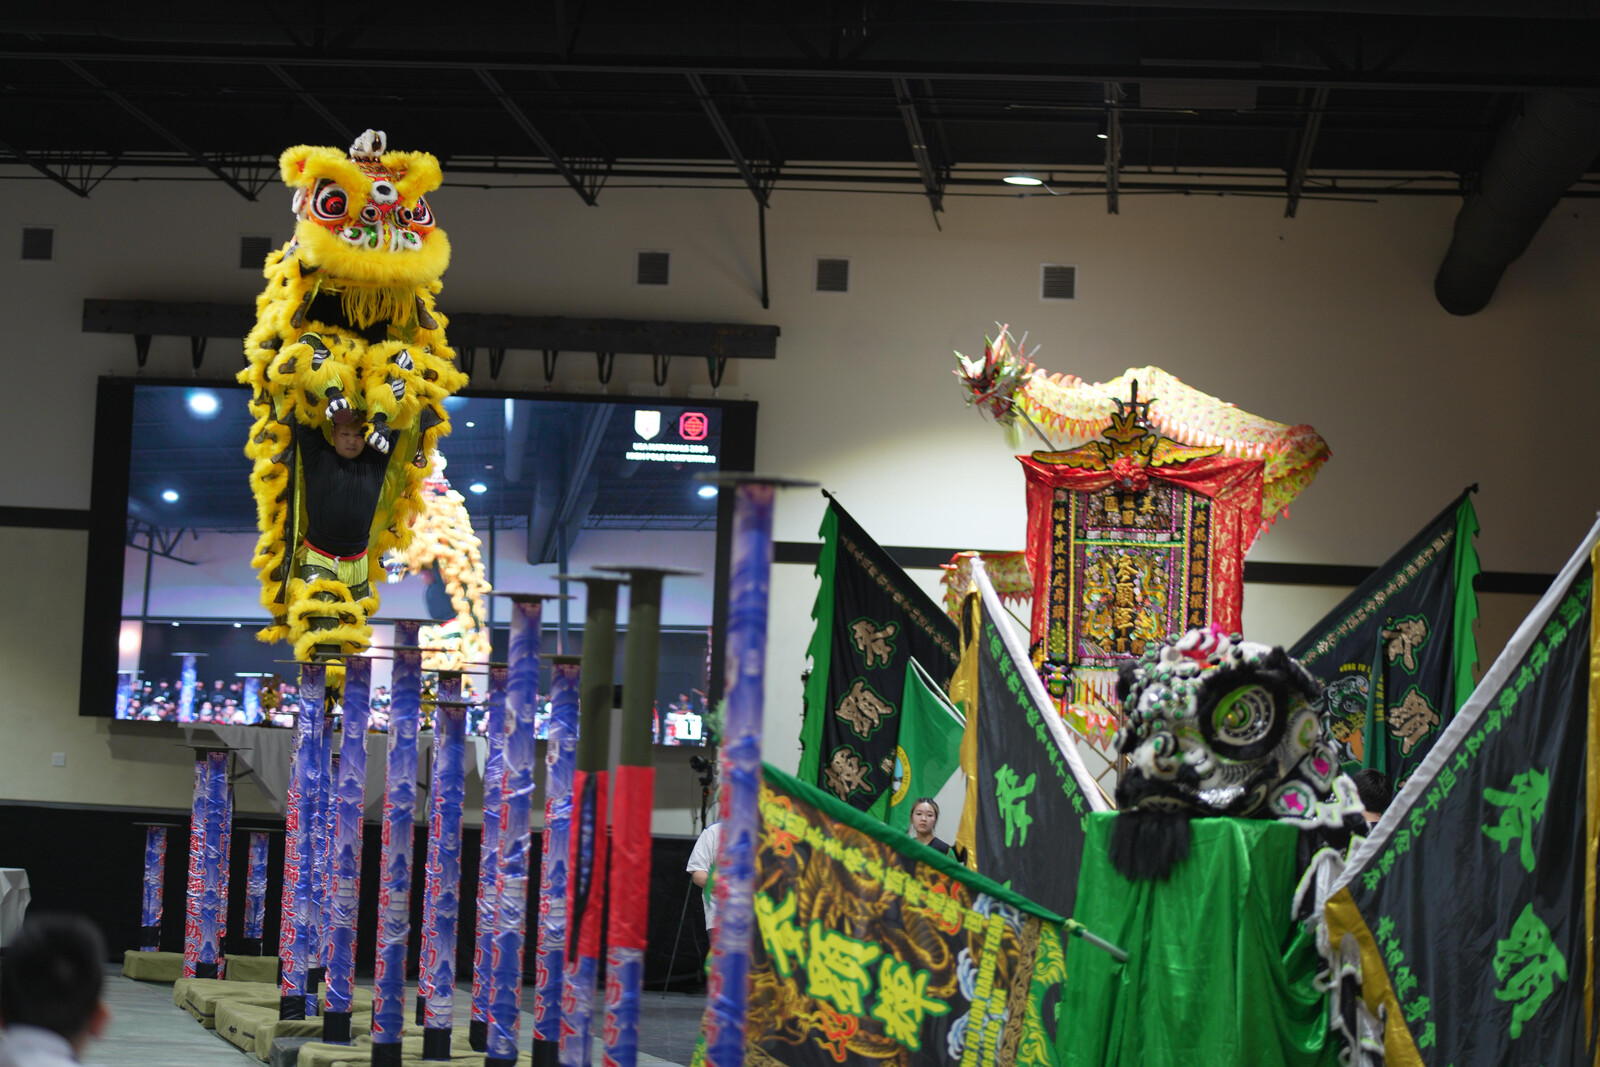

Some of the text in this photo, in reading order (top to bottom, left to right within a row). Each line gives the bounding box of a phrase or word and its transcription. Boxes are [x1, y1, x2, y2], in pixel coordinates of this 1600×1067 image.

[984, 912, 1006, 953] TEAM
[974, 950, 998, 999] DANCE
[967, 998, 987, 1032] LION
[988, 988, 1007, 1015] WA
[965, 1031, 981, 1050] FU
